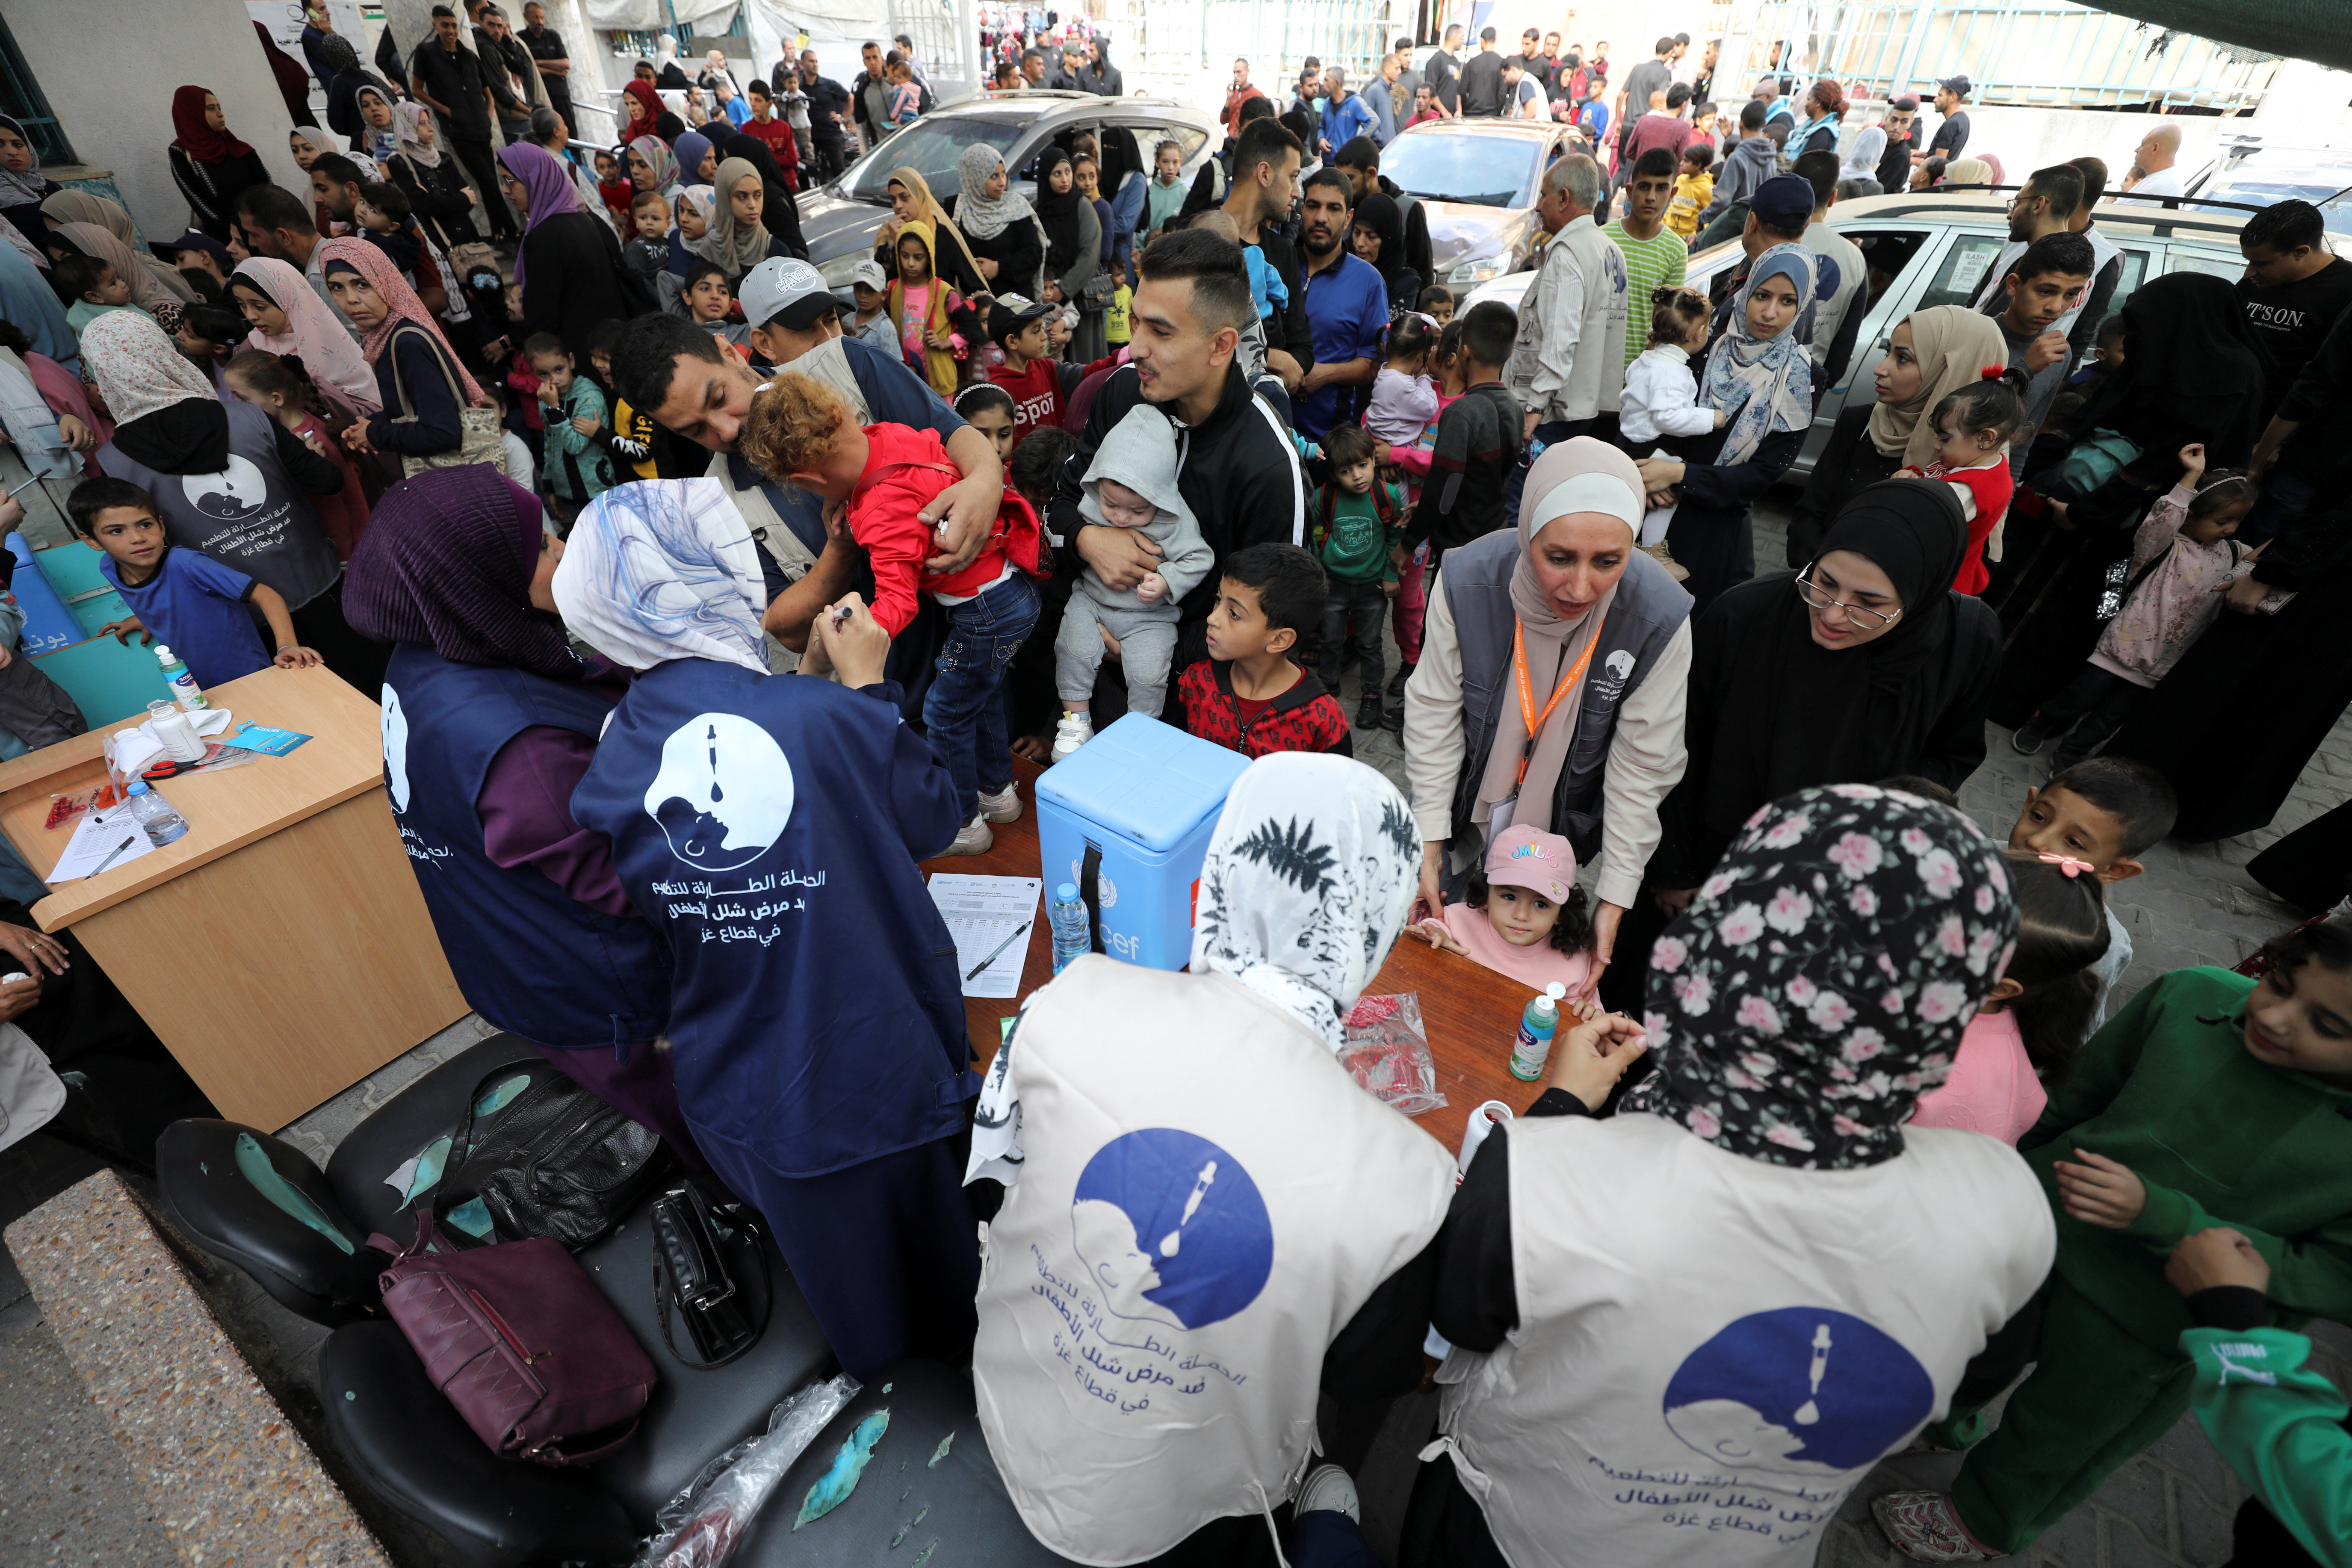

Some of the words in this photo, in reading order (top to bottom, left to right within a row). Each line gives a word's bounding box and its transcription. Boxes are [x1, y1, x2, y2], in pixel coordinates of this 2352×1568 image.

[2274, 309, 2305, 327] ON.
[1022, 395, 1043, 406] fashion
[274, 502, 291, 517] الحملة
[266, 523, 283, 535] مرض
[284, 516, 291, 526] ضد
[201, 529, 231, 549] للتطعيم
[248, 529, 265, 541] شلل
[274, 534, 285, 545] في
[219, 535, 247, 554] الأطفال
[241, 547, 255, 556] غزة
[254, 538, 273, 552] قطاع
[712, 903, 747, 921] شلل
[750, 901, 790, 920] مرض
[719, 926, 757, 943] قطاع
[759, 924, 781, 948] في
[1031, 1284, 1084, 1343] الأطفال
[1053, 1332, 1072, 1365] غزة
[1082, 1346, 1123, 1375] شلل
[1126, 1363, 1175, 1387] مرض
[1179, 1354, 1247, 1386] الحملة
[1074, 1364, 1118, 1405] قطاع
[1178, 1377, 1206, 1395] ضد
[1121, 1394, 1150, 1416] في
[1589, 1456, 1690, 1486] للتطعيم
[1715, 1494, 1773, 1512] شلل
[1662, 1511, 1702, 1527] غزة
[1707, 1515, 1773, 1536] قطاع
[1778, 1528, 1812, 1545] في
